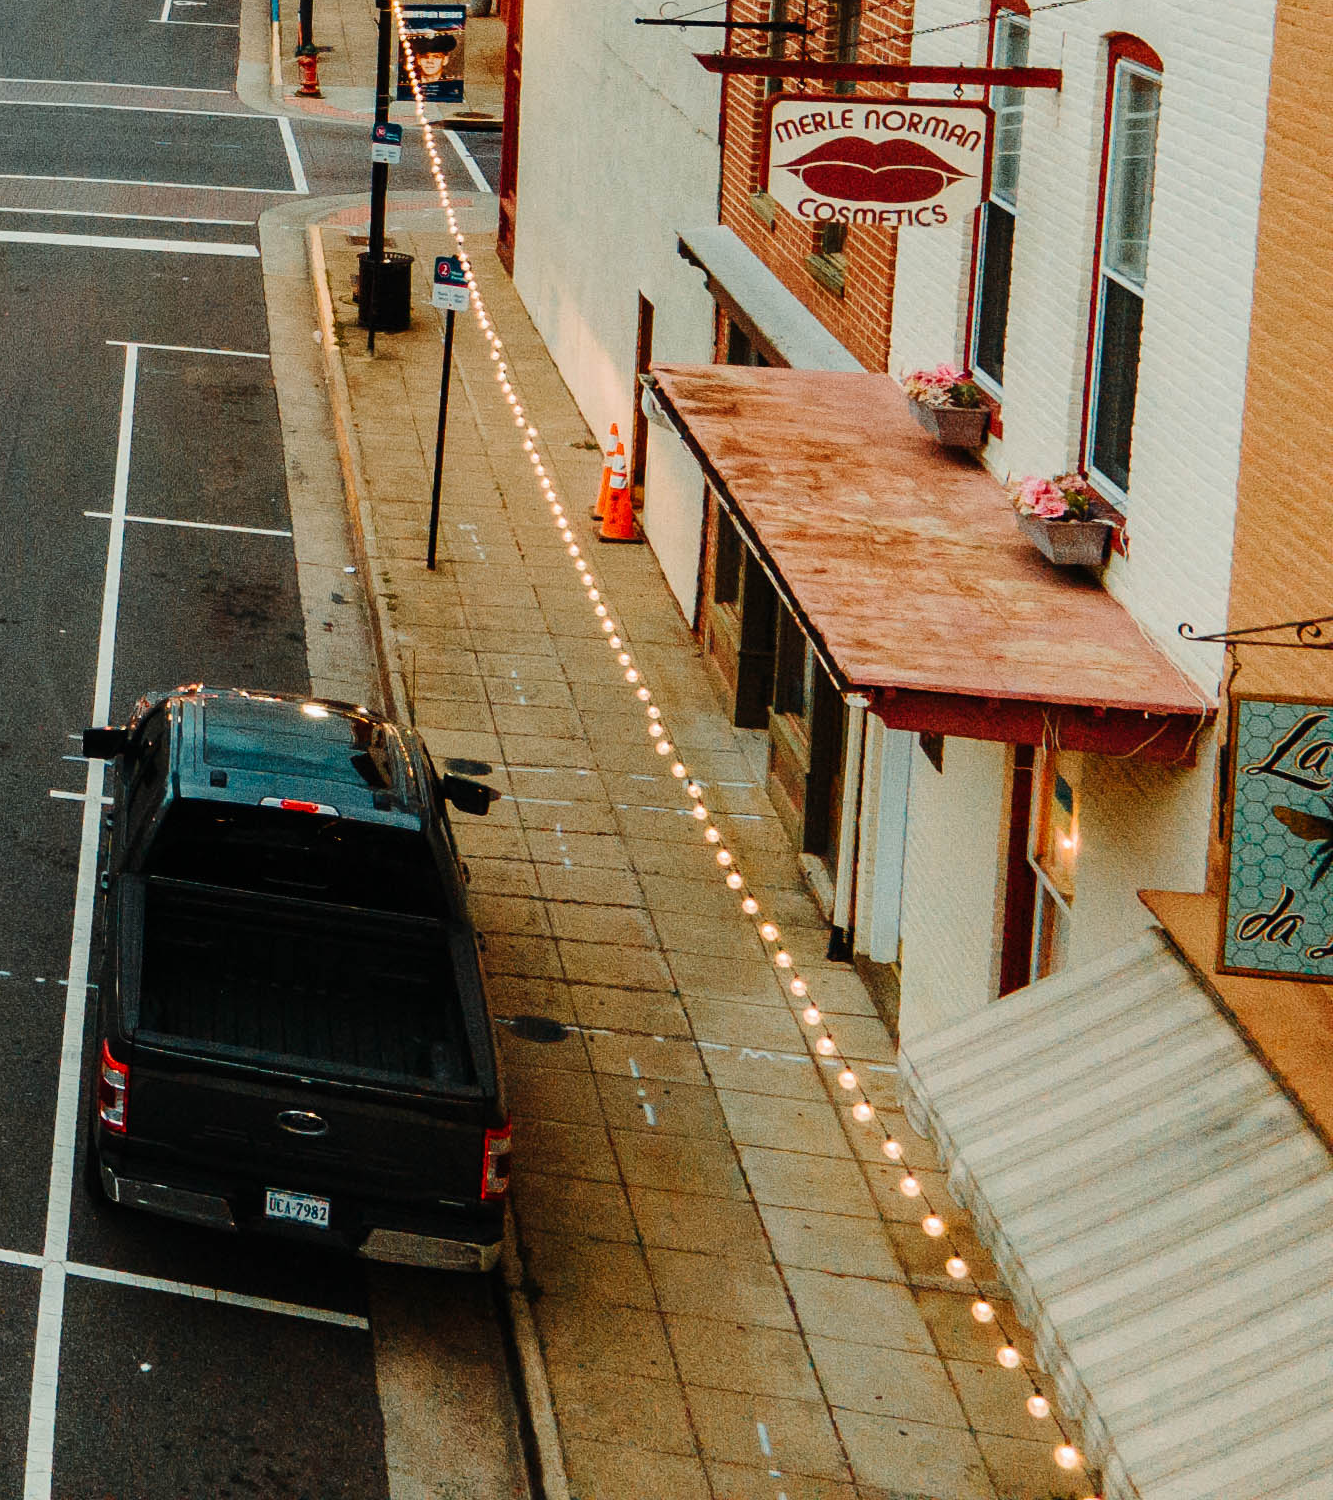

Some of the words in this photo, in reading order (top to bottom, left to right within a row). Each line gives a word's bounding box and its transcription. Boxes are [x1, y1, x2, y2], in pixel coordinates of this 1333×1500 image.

[774, 108, 854, 143] MERLE
[864, 109, 982, 152] NORMAN
[797, 198, 948, 227] COSMETICS
[268, 1196, 327, 1221] UCA-7982
